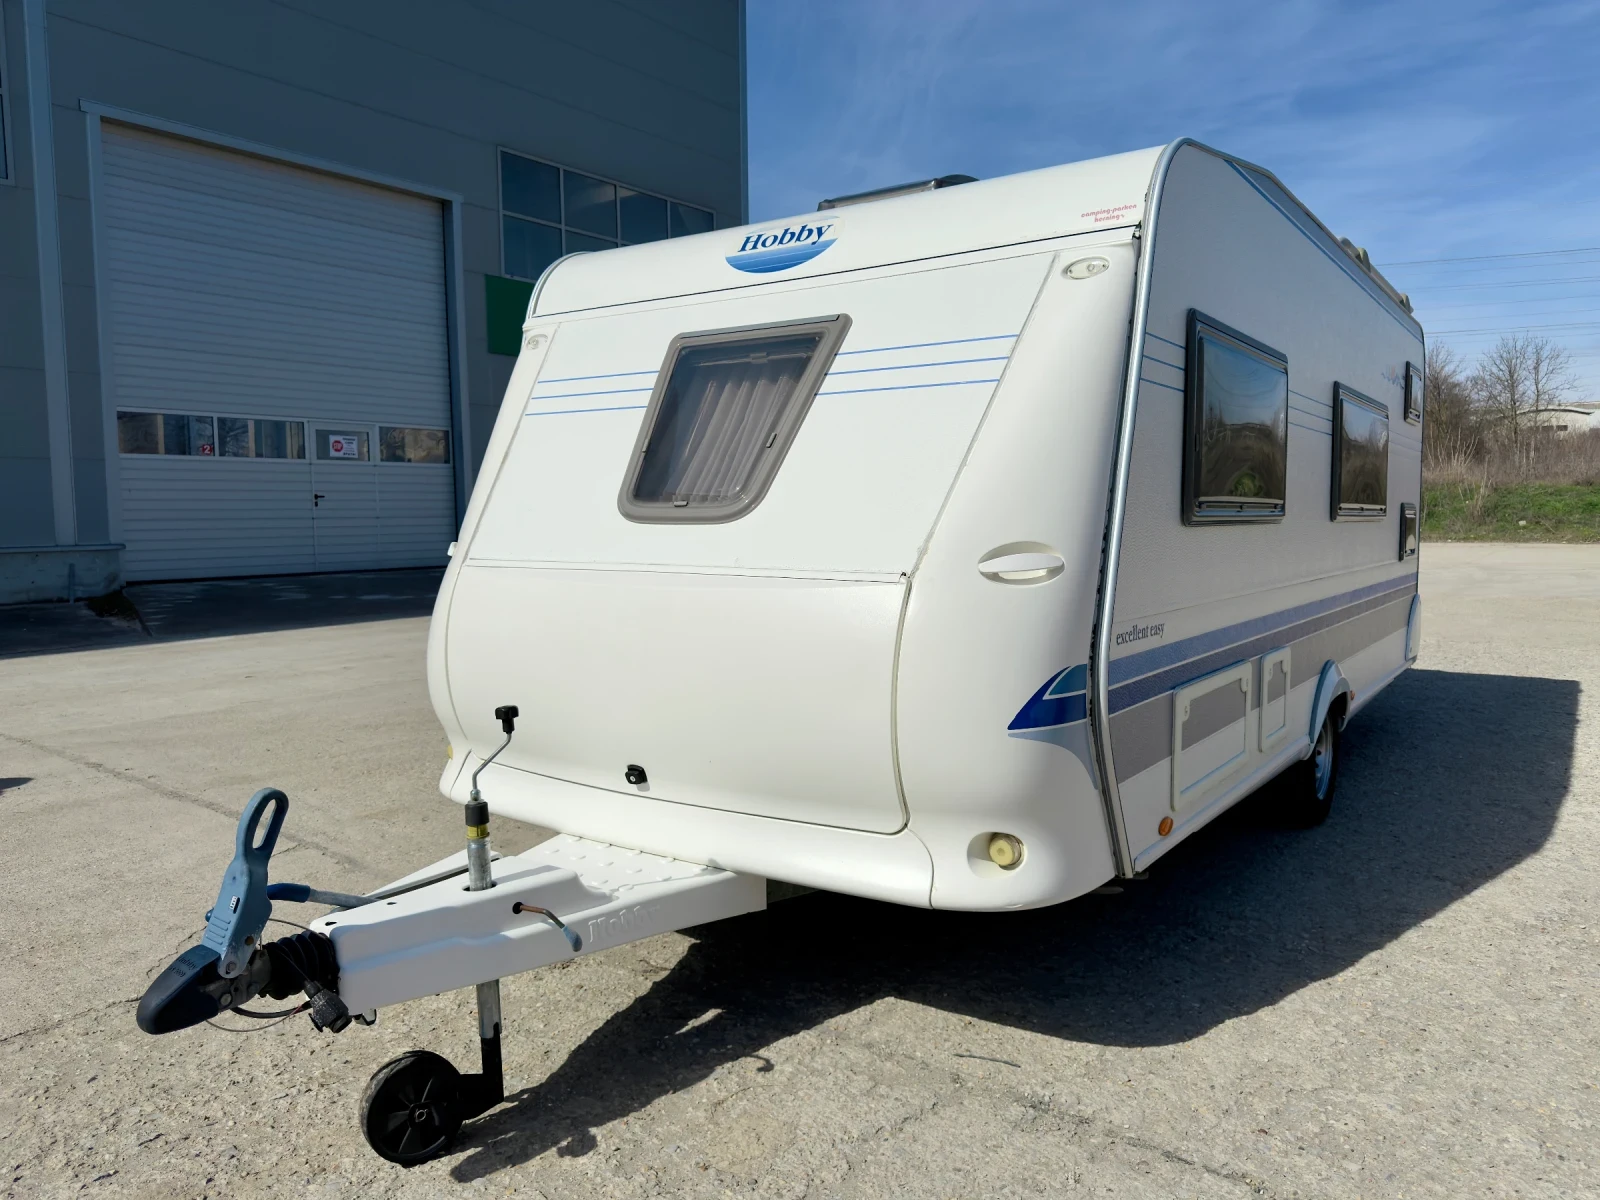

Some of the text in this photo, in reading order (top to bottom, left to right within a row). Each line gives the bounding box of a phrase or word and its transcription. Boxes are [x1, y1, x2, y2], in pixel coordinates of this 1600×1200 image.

[737, 224, 834, 253] Hobby
[203, 444, 211, 454] 2
[1116, 623, 1165, 646] excellent easy
